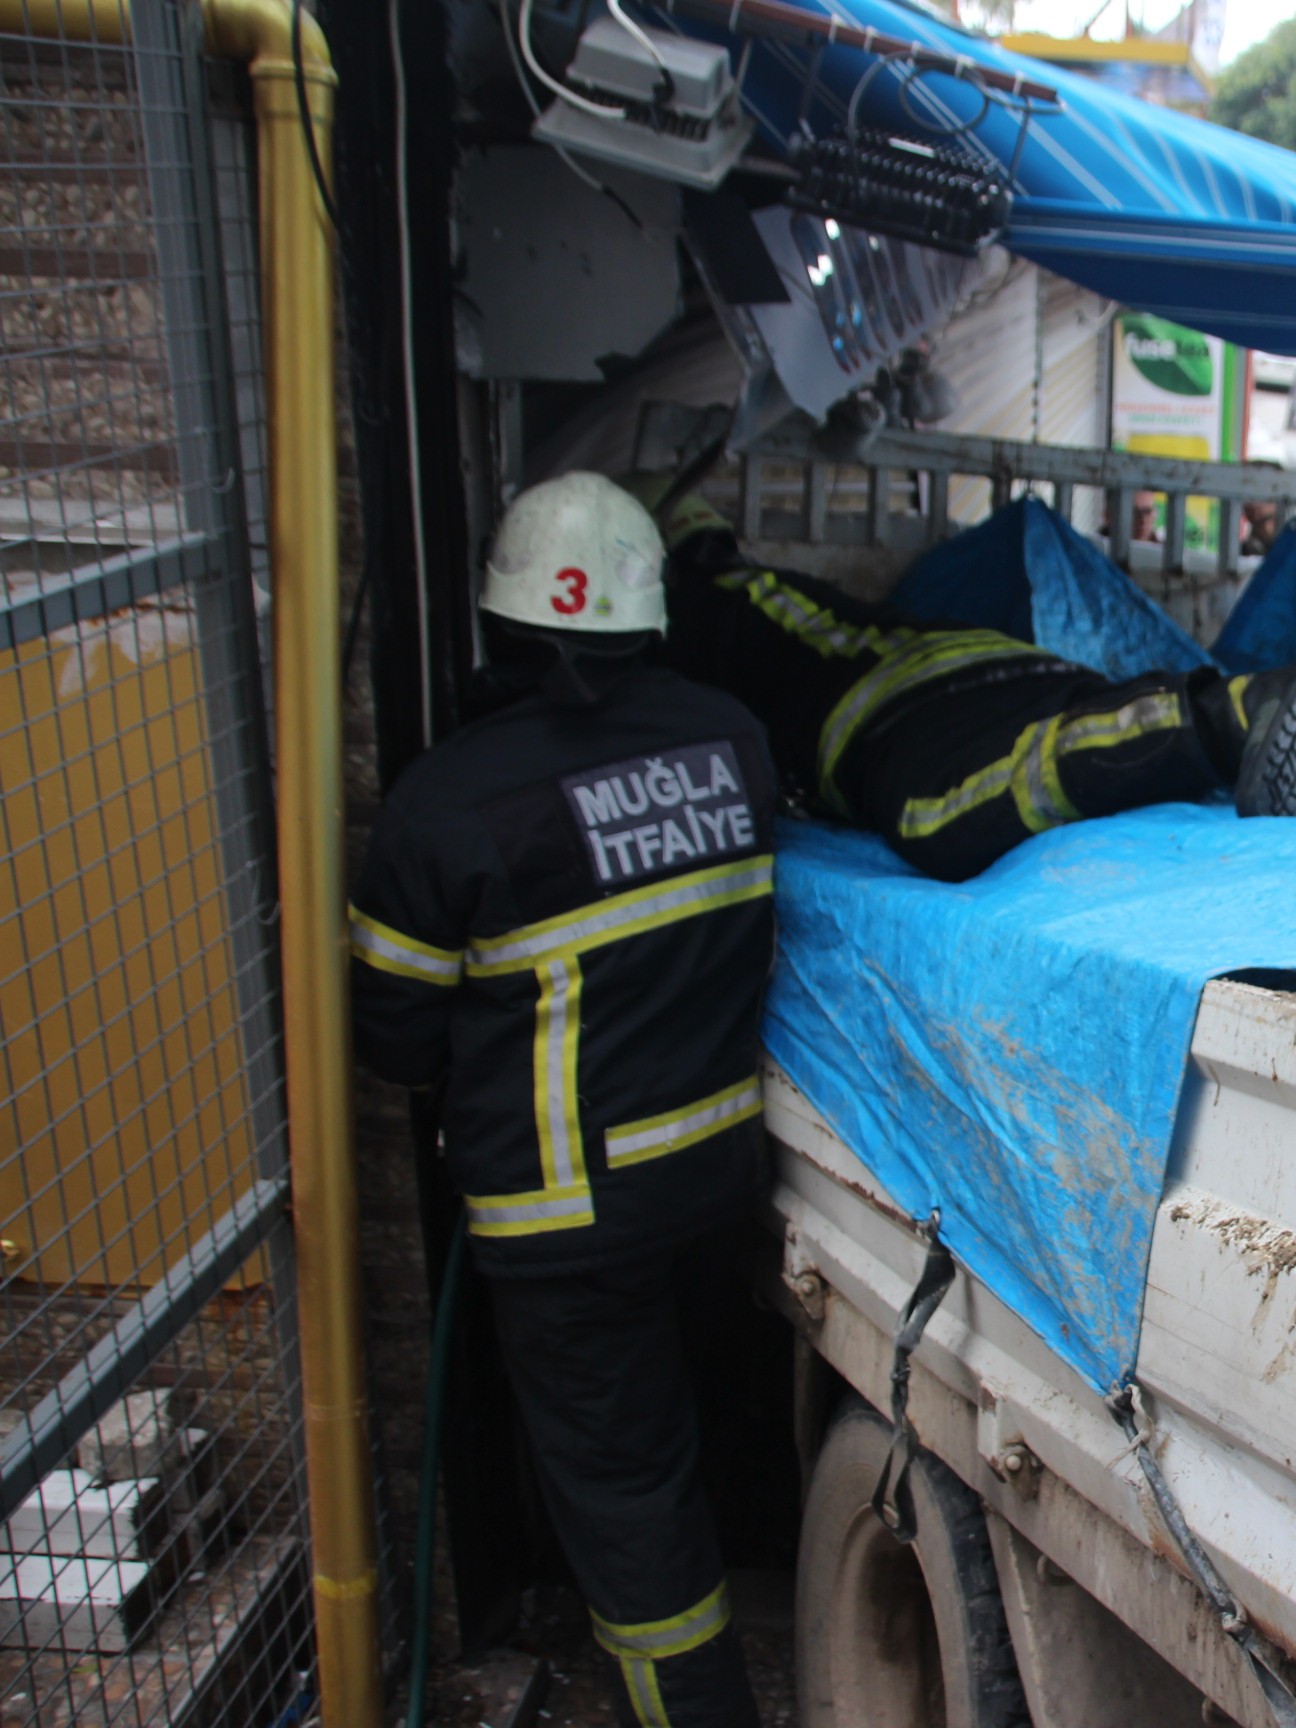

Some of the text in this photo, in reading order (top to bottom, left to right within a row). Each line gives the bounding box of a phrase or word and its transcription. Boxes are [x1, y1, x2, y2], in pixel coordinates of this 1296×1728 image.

[550, 566, 588, 615] 3
[572, 754, 740, 828] MUĞLA
[587, 803, 755, 881] İTFAİYE
